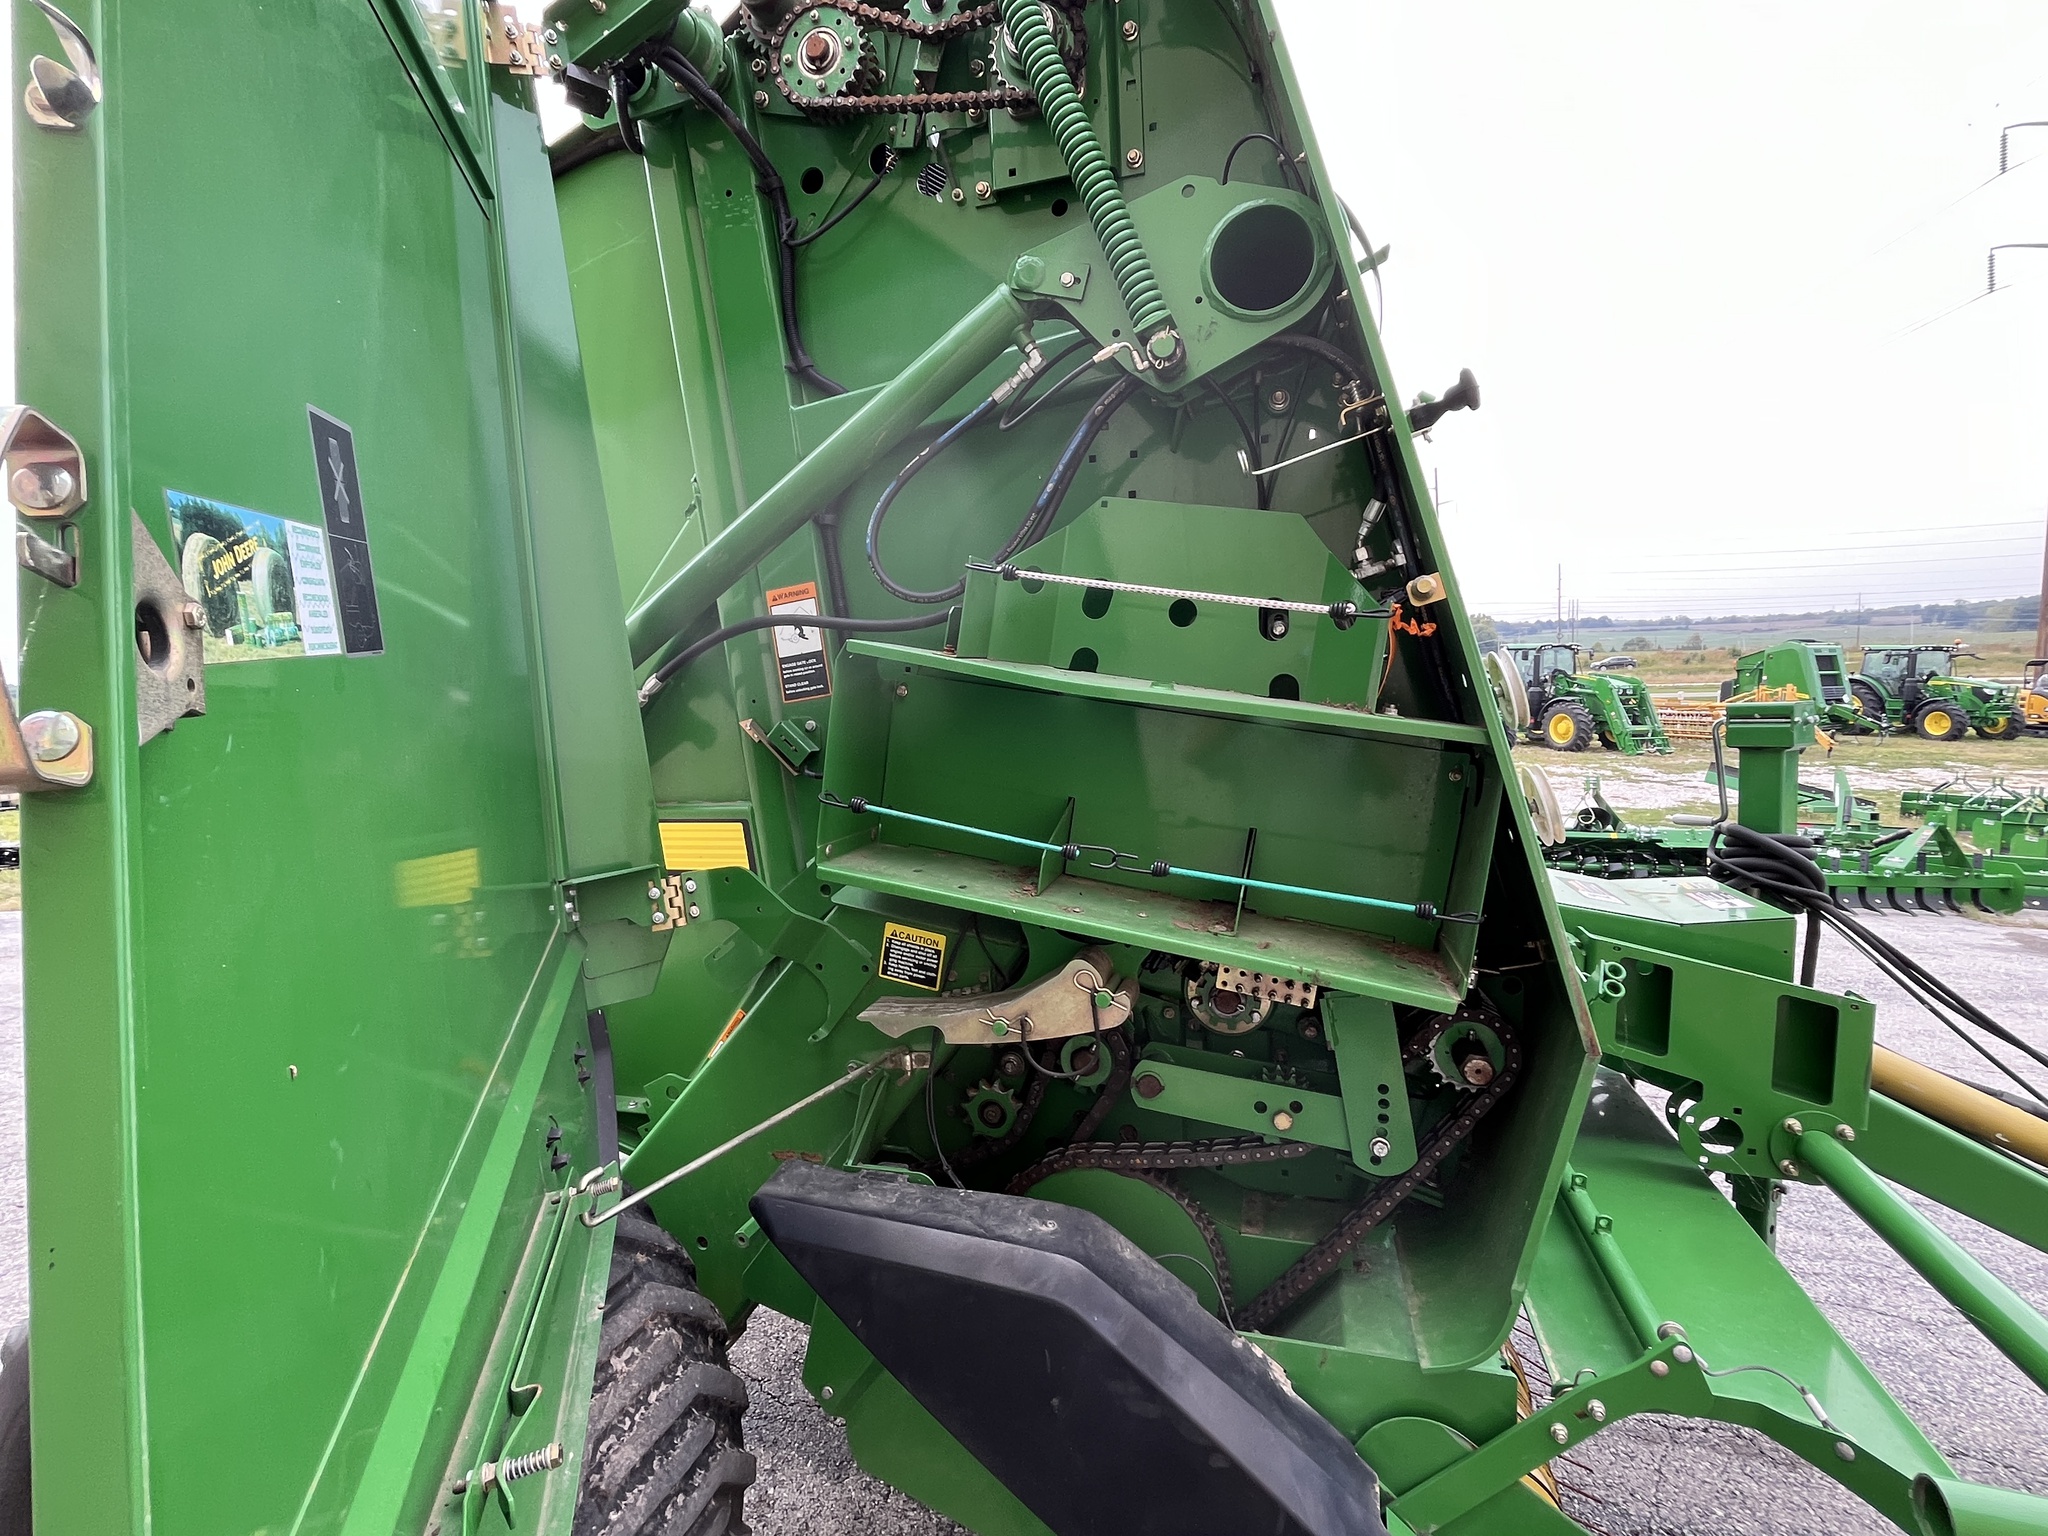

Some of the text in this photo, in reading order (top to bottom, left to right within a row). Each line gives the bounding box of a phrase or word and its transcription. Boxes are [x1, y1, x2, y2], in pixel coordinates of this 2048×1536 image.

[212, 536, 258, 580] JOHN DEERE
[777, 588, 809, 601] WARNING
[898, 931, 939, 948] CAUTION
